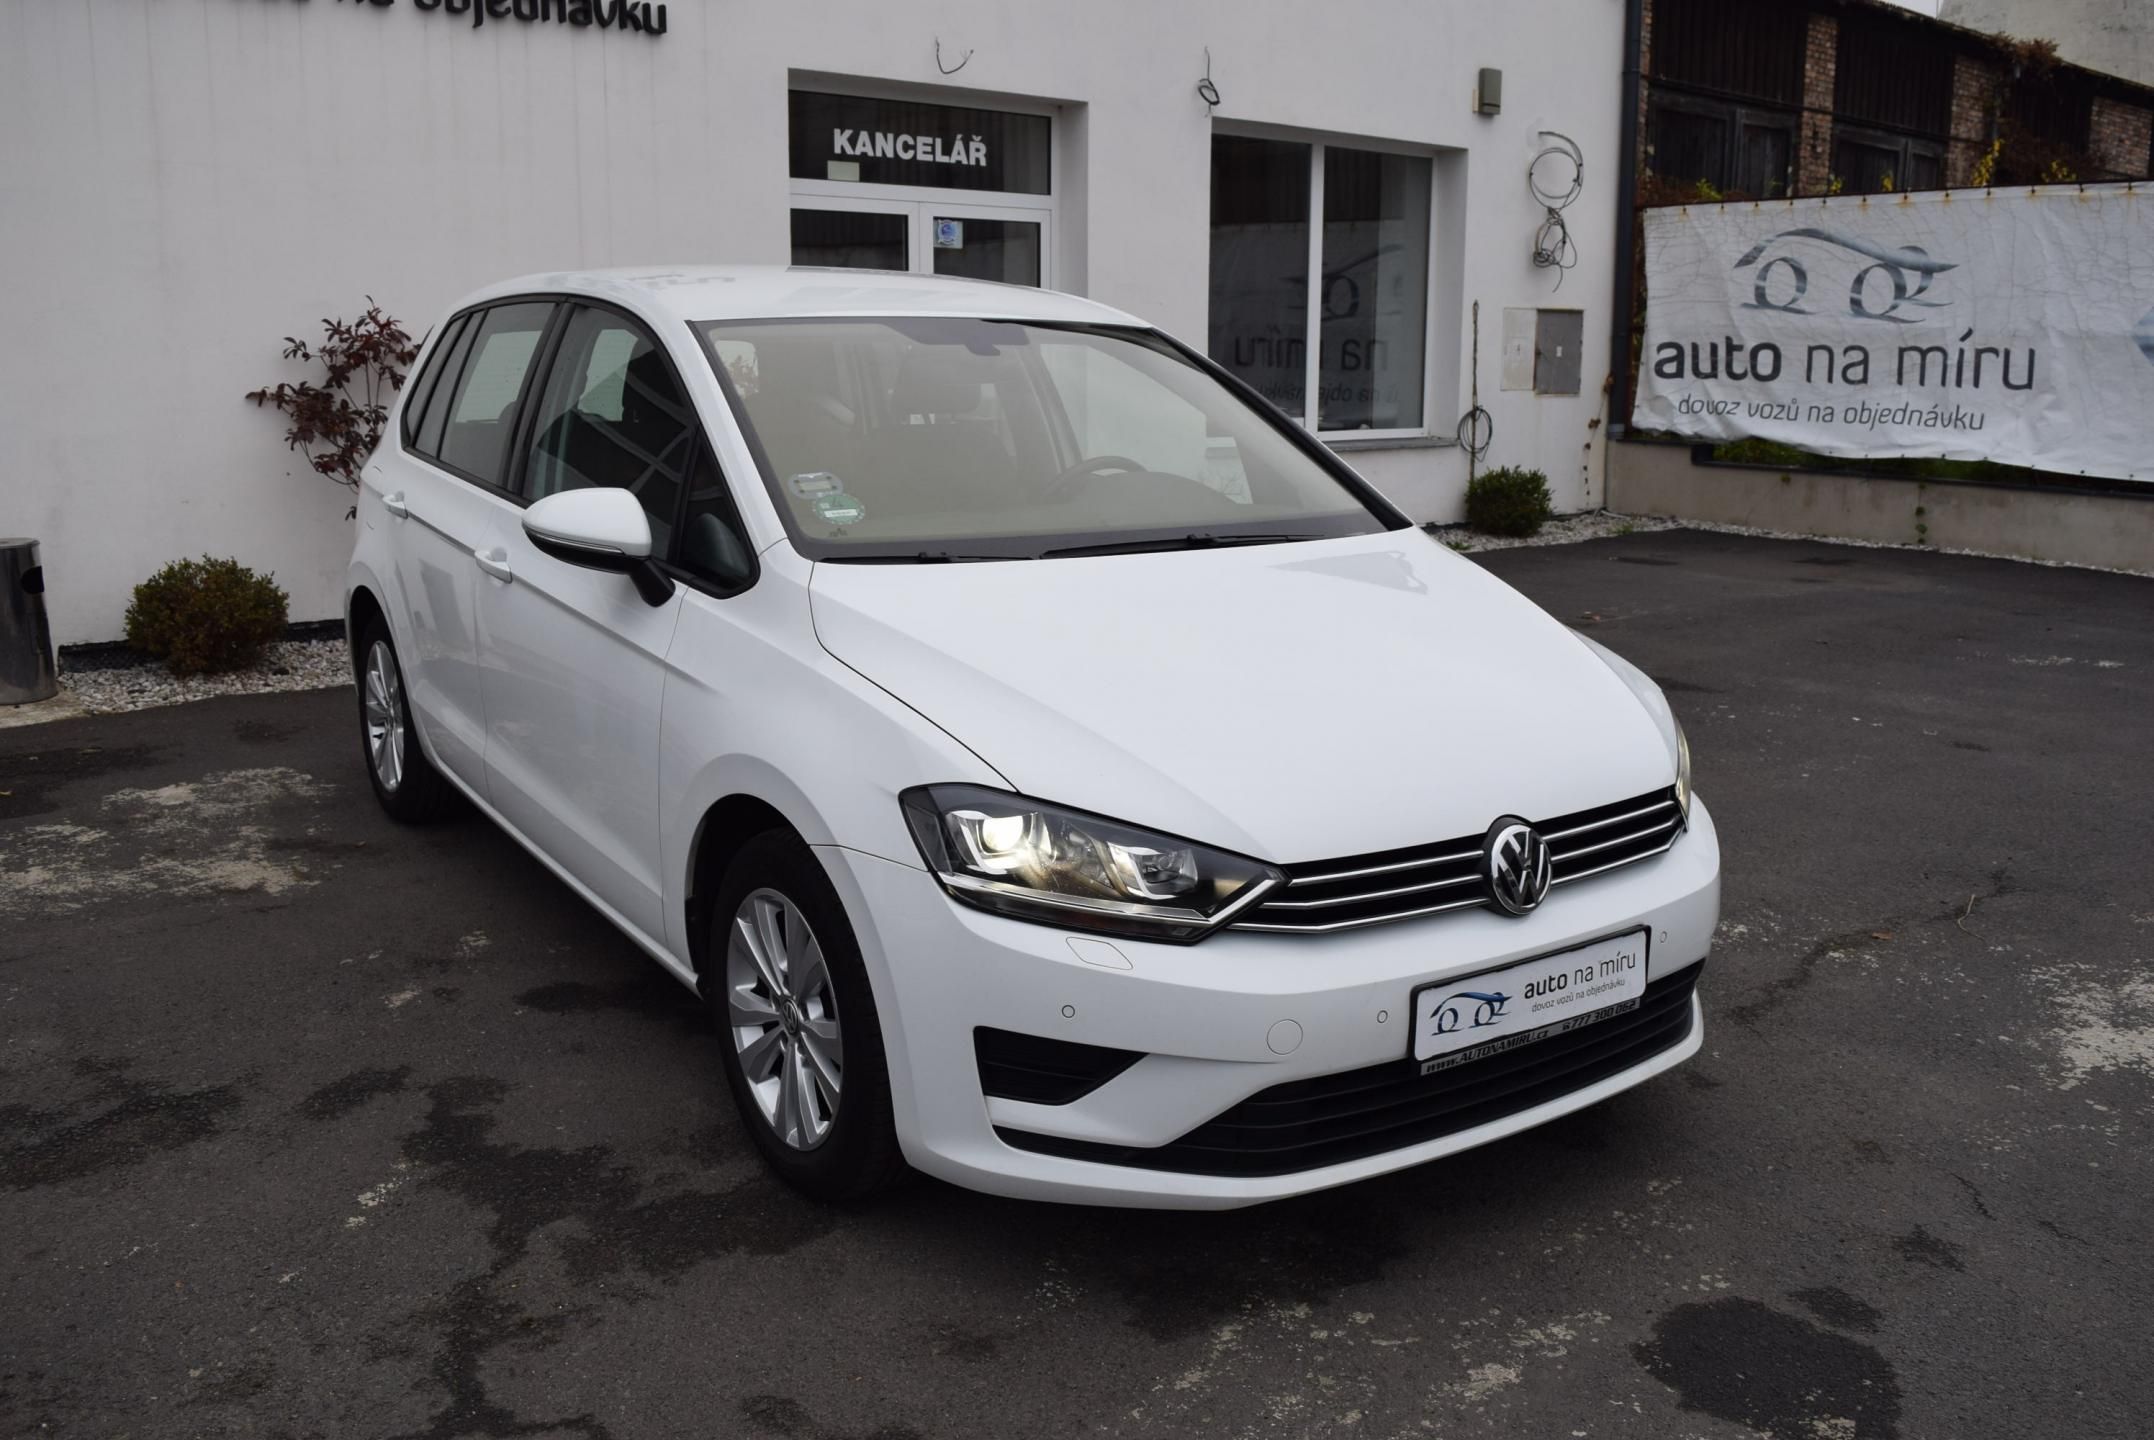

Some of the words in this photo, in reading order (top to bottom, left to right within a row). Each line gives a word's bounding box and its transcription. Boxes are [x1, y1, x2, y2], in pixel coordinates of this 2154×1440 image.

[834, 128, 987, 167] KANCELÁŘ
[1654, 336, 1782, 382] auto
[1806, 343, 1869, 385] na
[1897, 328, 2035, 390] míru
[1678, 393, 1741, 416] dovoz
[1748, 398, 1800, 422] vozů
[1807, 404, 1835, 424] na
[1843, 401, 1985, 431] objednávku
[1524, 973, 1568, 999] auto
[1574, 966, 1594, 986] na
[1600, 951, 1636, 978] míru
[1531, 1000, 1555, 1013] dovoz
[1575, 990, 1585, 1000] na
